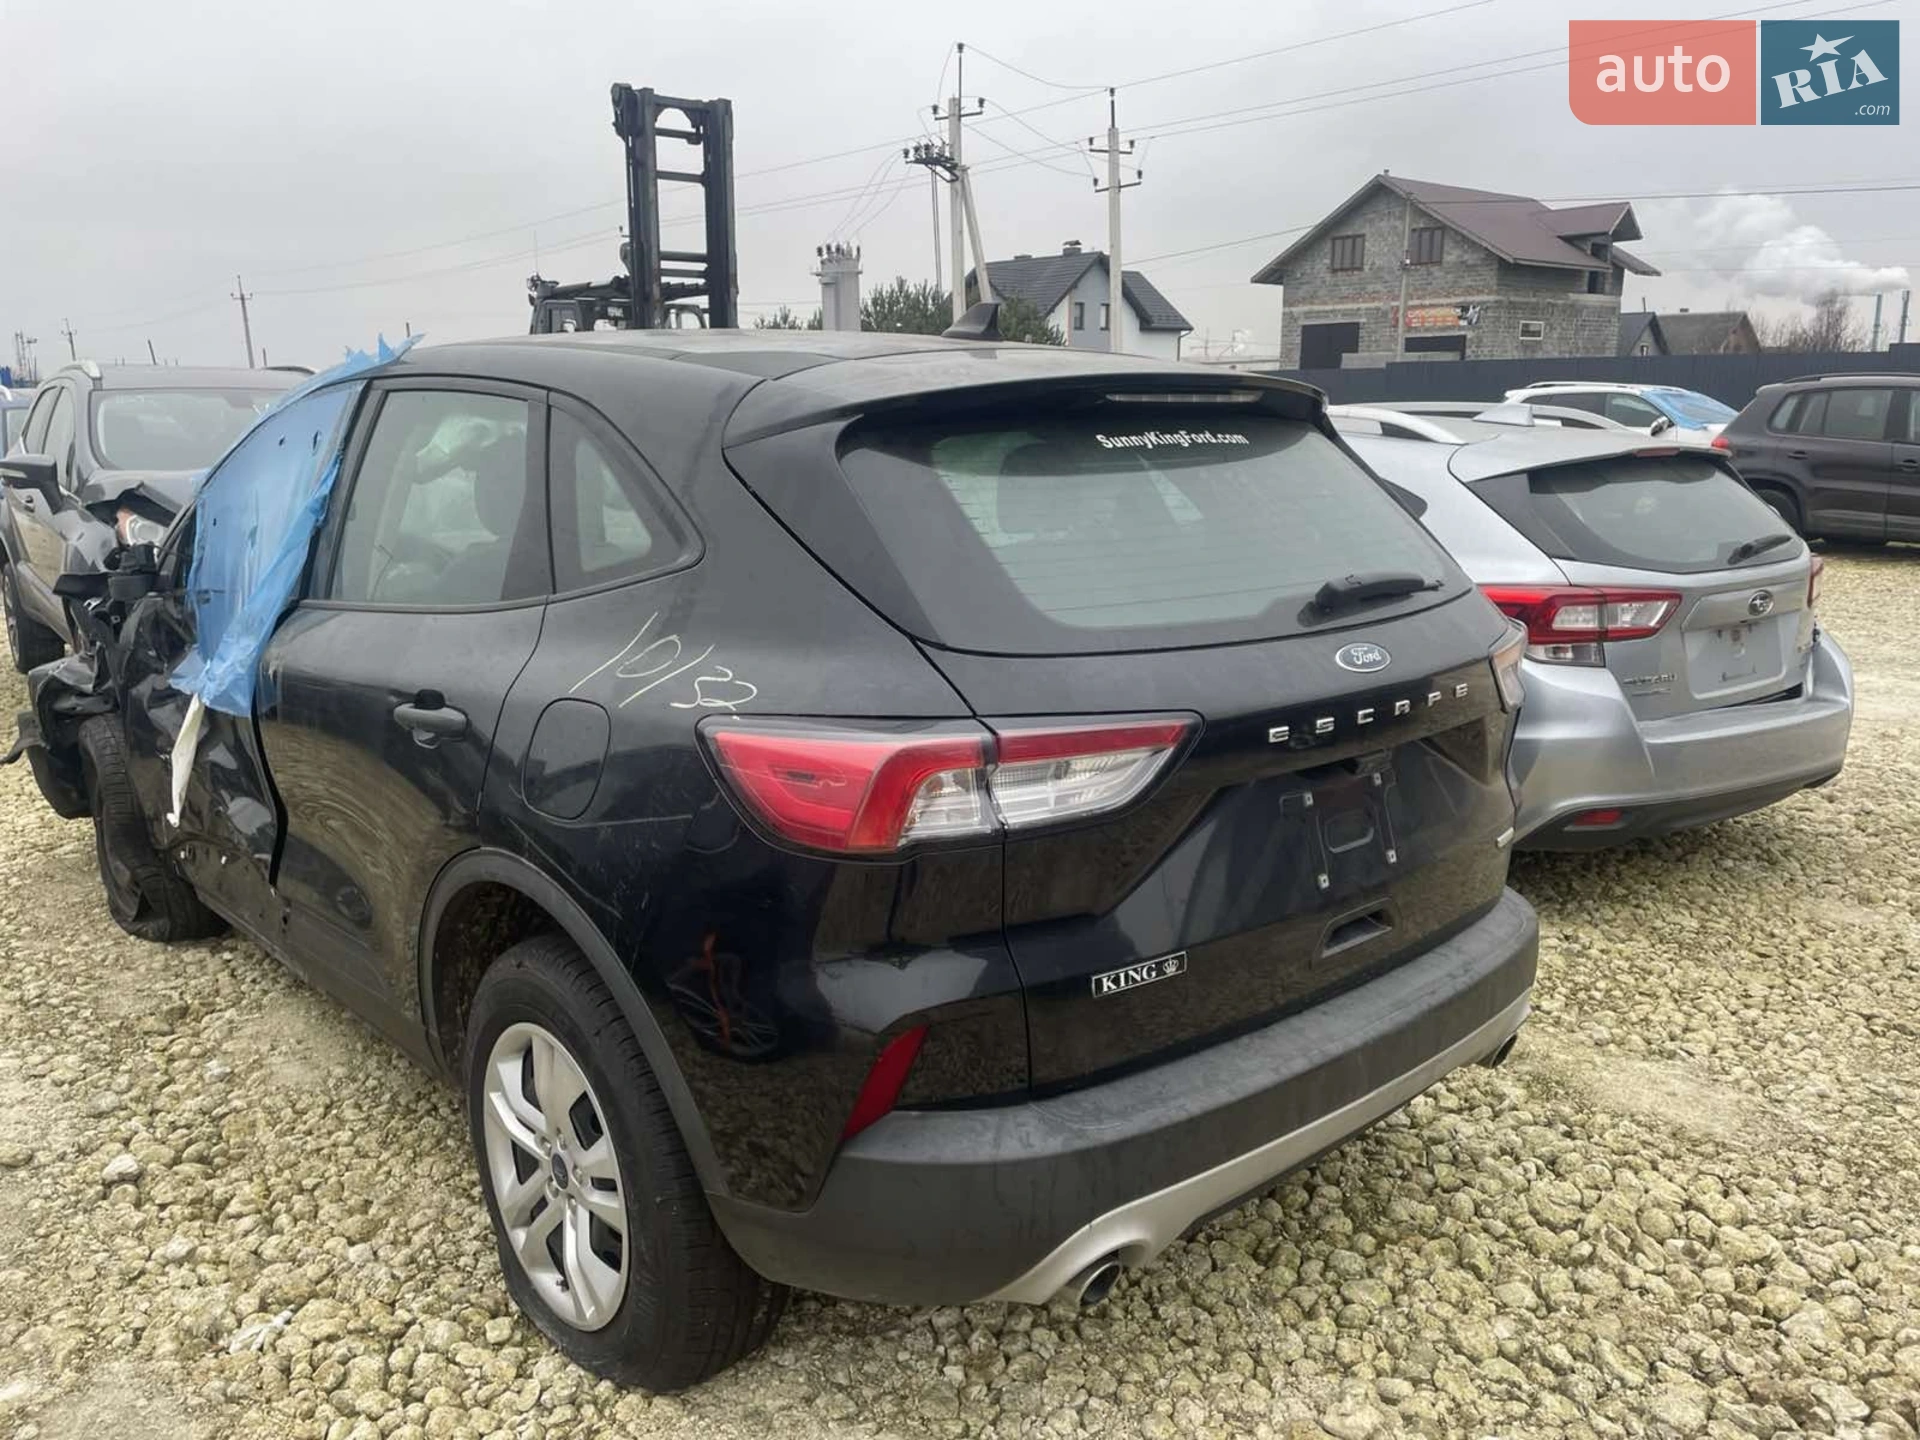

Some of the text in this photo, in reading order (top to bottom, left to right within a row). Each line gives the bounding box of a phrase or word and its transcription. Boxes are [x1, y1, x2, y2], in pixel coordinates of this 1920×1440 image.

[1096, 430, 1249, 449] SunnyKingFord.com
[1268, 683, 1468, 743] ESCAPE
[1101, 964, 1157, 993] KING
